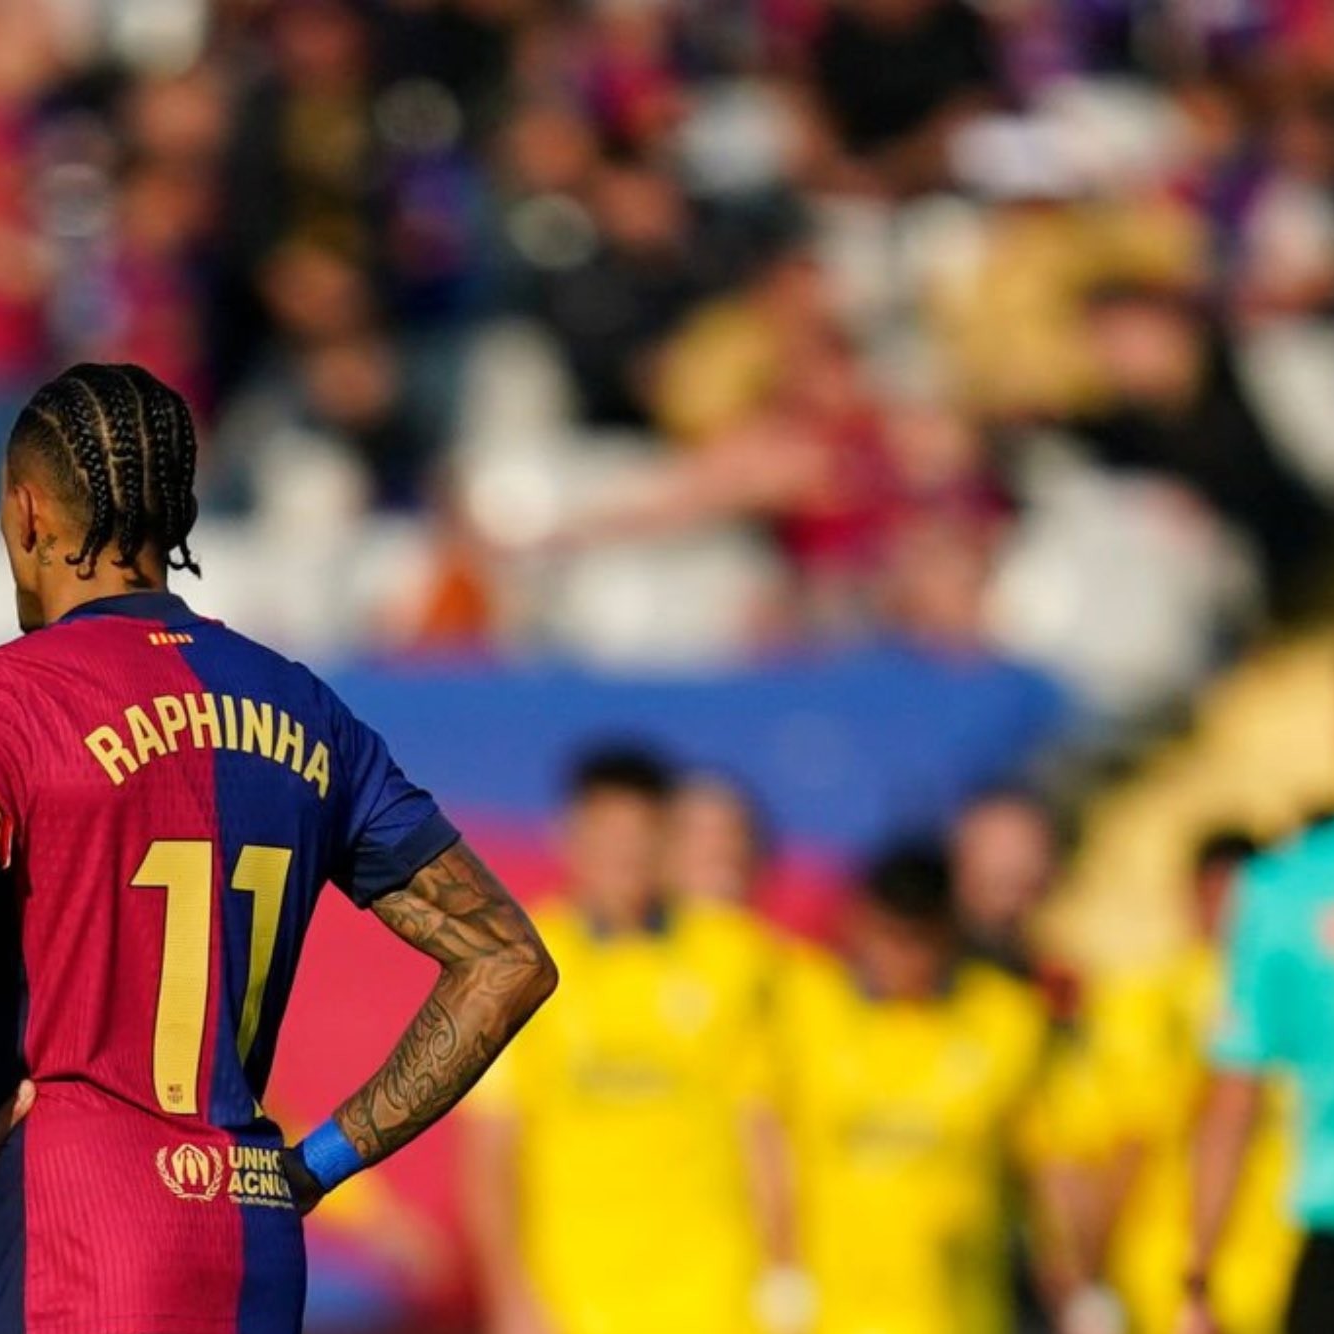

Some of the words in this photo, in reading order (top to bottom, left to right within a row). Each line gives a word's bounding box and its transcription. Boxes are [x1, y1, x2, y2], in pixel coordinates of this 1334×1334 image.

[84, 692, 329, 799] RAPHINHA
[130, 840, 292, 1116] 11
[227, 1145, 282, 1172] UNHC
[227, 1170, 292, 1199] ACNU
